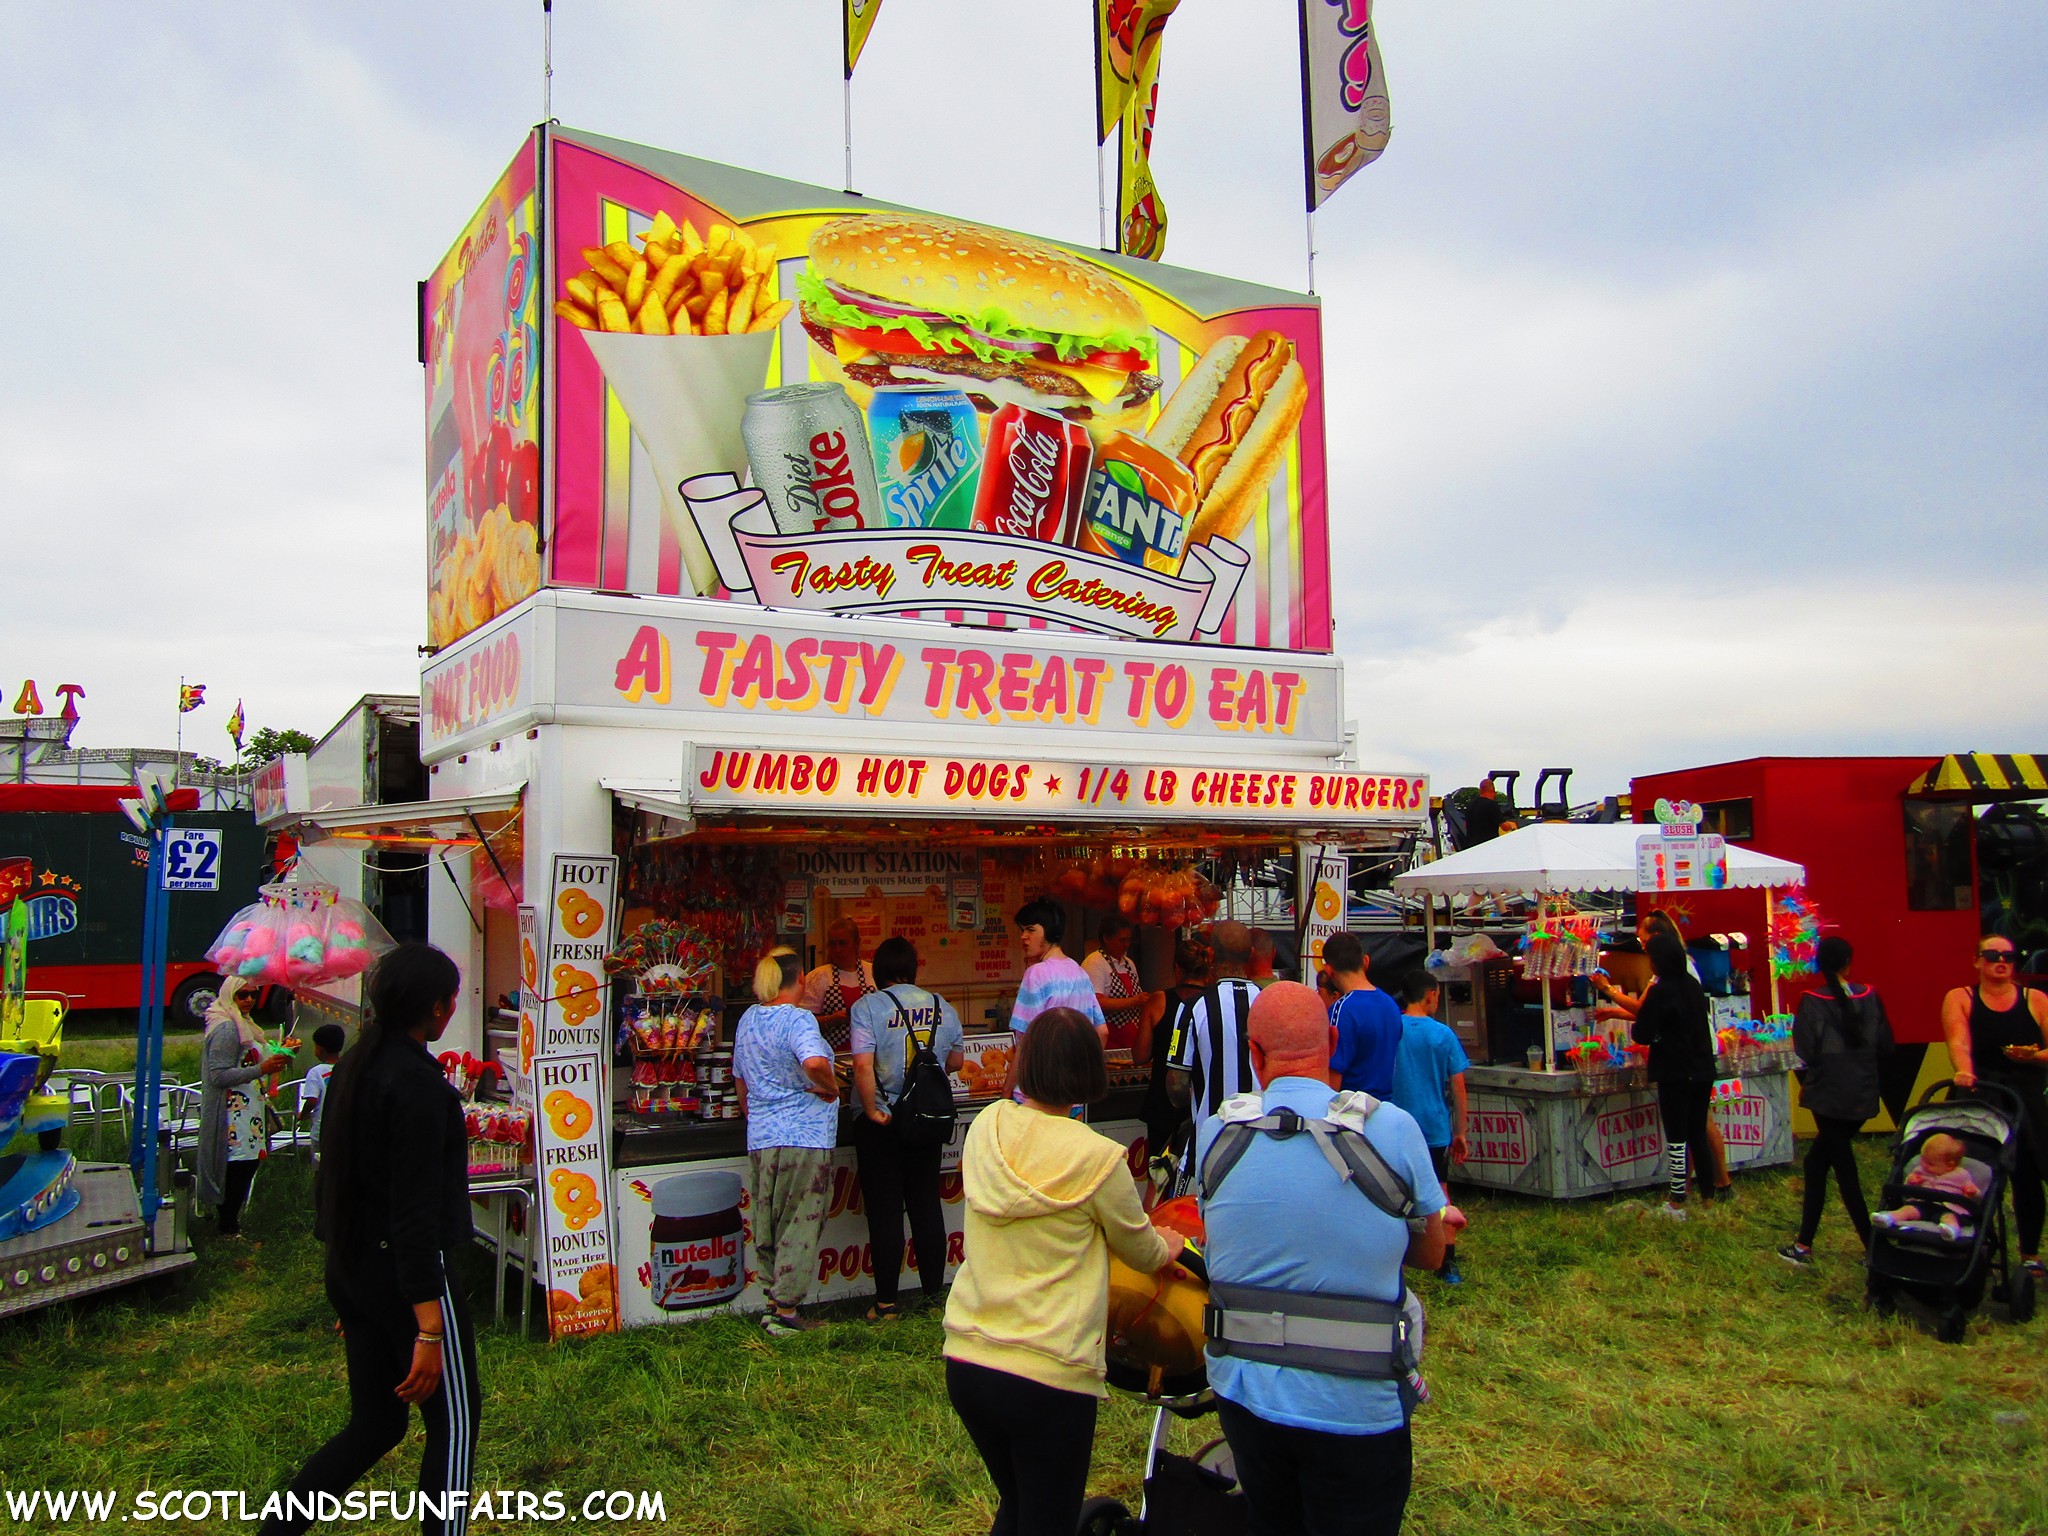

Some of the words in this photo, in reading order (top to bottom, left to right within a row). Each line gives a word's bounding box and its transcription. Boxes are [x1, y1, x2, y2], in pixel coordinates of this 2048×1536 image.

[784, 452, 822, 515] Diet
[886, 436, 968, 527] Sprite
[1093, 521, 1130, 547] orange
[770, 551, 896, 600] Tasty
[905, 544, 1017, 587] Treat
[1026, 560, 1180, 638] Catering
[431, 661, 467, 740] HOT
[468, 632, 521, 727] FOOD
[614, 625, 671, 705] A
[695, 630, 905, 716] TASTY
[920, 646, 1114, 726] TREAT
[1124, 661, 1195, 729] TO
[1208, 667, 1306, 735] EAT
[700, 751, 841, 795] JUMBO
[856, 757, 929, 799] HOT
[943, 761, 1032, 803] DOGS
[1077, 765, 1130, 804] 1/4
[1144, 769, 1178, 806] LB
[1191, 771, 1296, 810] CHEESE
[1309, 775, 1425, 813] BURGERS
[184, 831, 204, 840] Fare
[1664, 823, 1694, 836] SLUSH
[120, 831, 150, 848] ROLLIN
[167, 840, 219, 879] £2
[796, 851, 869, 874] DONUT
[875, 851, 961, 874] STATION
[561, 864, 609, 885] HOT
[813, 877, 829, 886] HOT
[832, 876, 859, 886] FRESH
[862, 875, 895, 885] DONUTS
[898, 875, 922, 884] MADE
[925, 874, 946, 884] HERE
[169, 881, 182, 889] per
[184, 880, 212, 889] person
[984, 883, 1005, 892] ANDY
[520, 914, 534, 933] HOT
[894, 916, 923, 925] JUMBO
[891, 927, 907, 937] HOT
[909, 927, 926, 937] DOG
[553, 944, 604, 961] FRESH
[980, 950, 1006, 959] SUGAR
[975, 960, 1011, 970] DUMMIES
[548, 1028, 600, 1045] DONUTS
[973, 1042, 1009, 1054] DONUTS
[543, 1063, 591, 1086] HOT
[1601, 1108, 1656, 1137] CANDY
[545, 1143, 599, 1166] FRESH
[943, 1151, 959, 1159] ESH
[1604, 1133, 1658, 1162] CARTS
[1667, 1142, 1687, 1195] EVERLAST
[552, 1230, 606, 1254] DONUTS
[662, 1236, 737, 1265] nutella
[552, 1257, 580, 1268] MADE
[582, 1253, 607, 1263] HERE
[557, 1266, 585, 1278] EVERY
[586, 1263, 602, 1272] DAY
[558, 1313, 575, 1323] ANY
[576, 1308, 612, 1320] TOPPING
[574, 1318, 606, 1331] EXTRA
